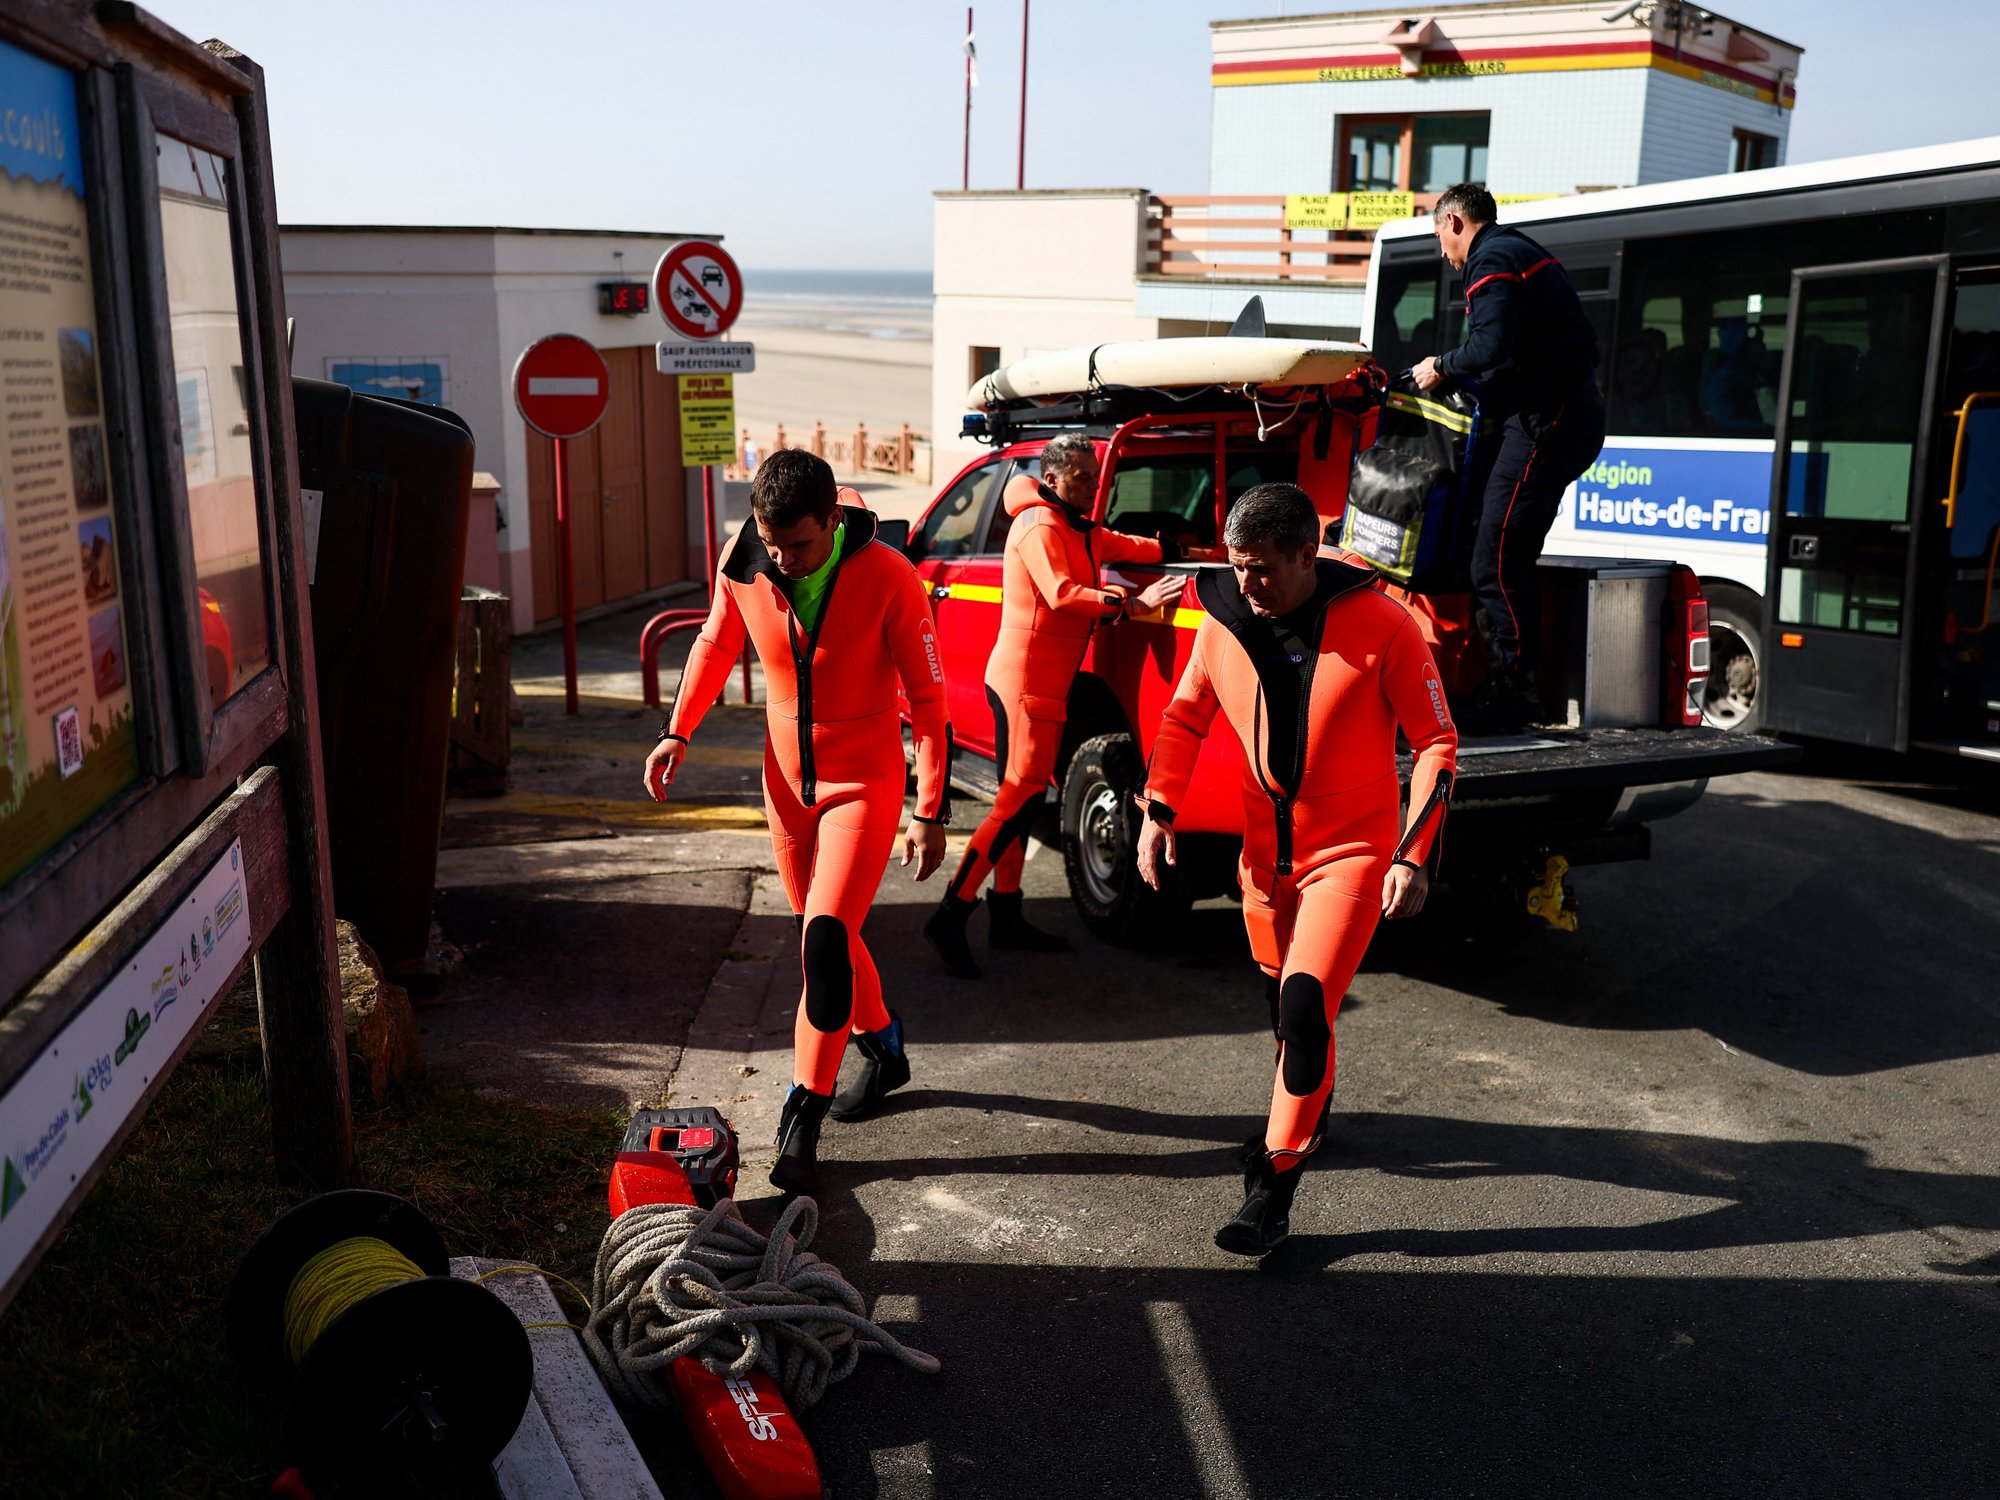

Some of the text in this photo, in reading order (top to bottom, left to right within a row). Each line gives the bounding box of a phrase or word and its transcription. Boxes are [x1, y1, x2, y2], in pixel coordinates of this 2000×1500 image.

[1319, 67, 1401, 81] SAUVETEURS
[0, 107, 65, 161] coult
[1353, 195, 1408, 205] POSTE DE
[1356, 207, 1408, 217] SECOURS
[613, 288, 646, 308] JE 9
[662, 346, 751, 356] SAUF AUTORISATION
[674, 359, 742, 369] PRÉFECTORALE
[1580, 460, 1652, 490] Région
[1356, 511, 1398, 537] SAPEURS
[1354, 522, 1398, 549] POMPIERS
